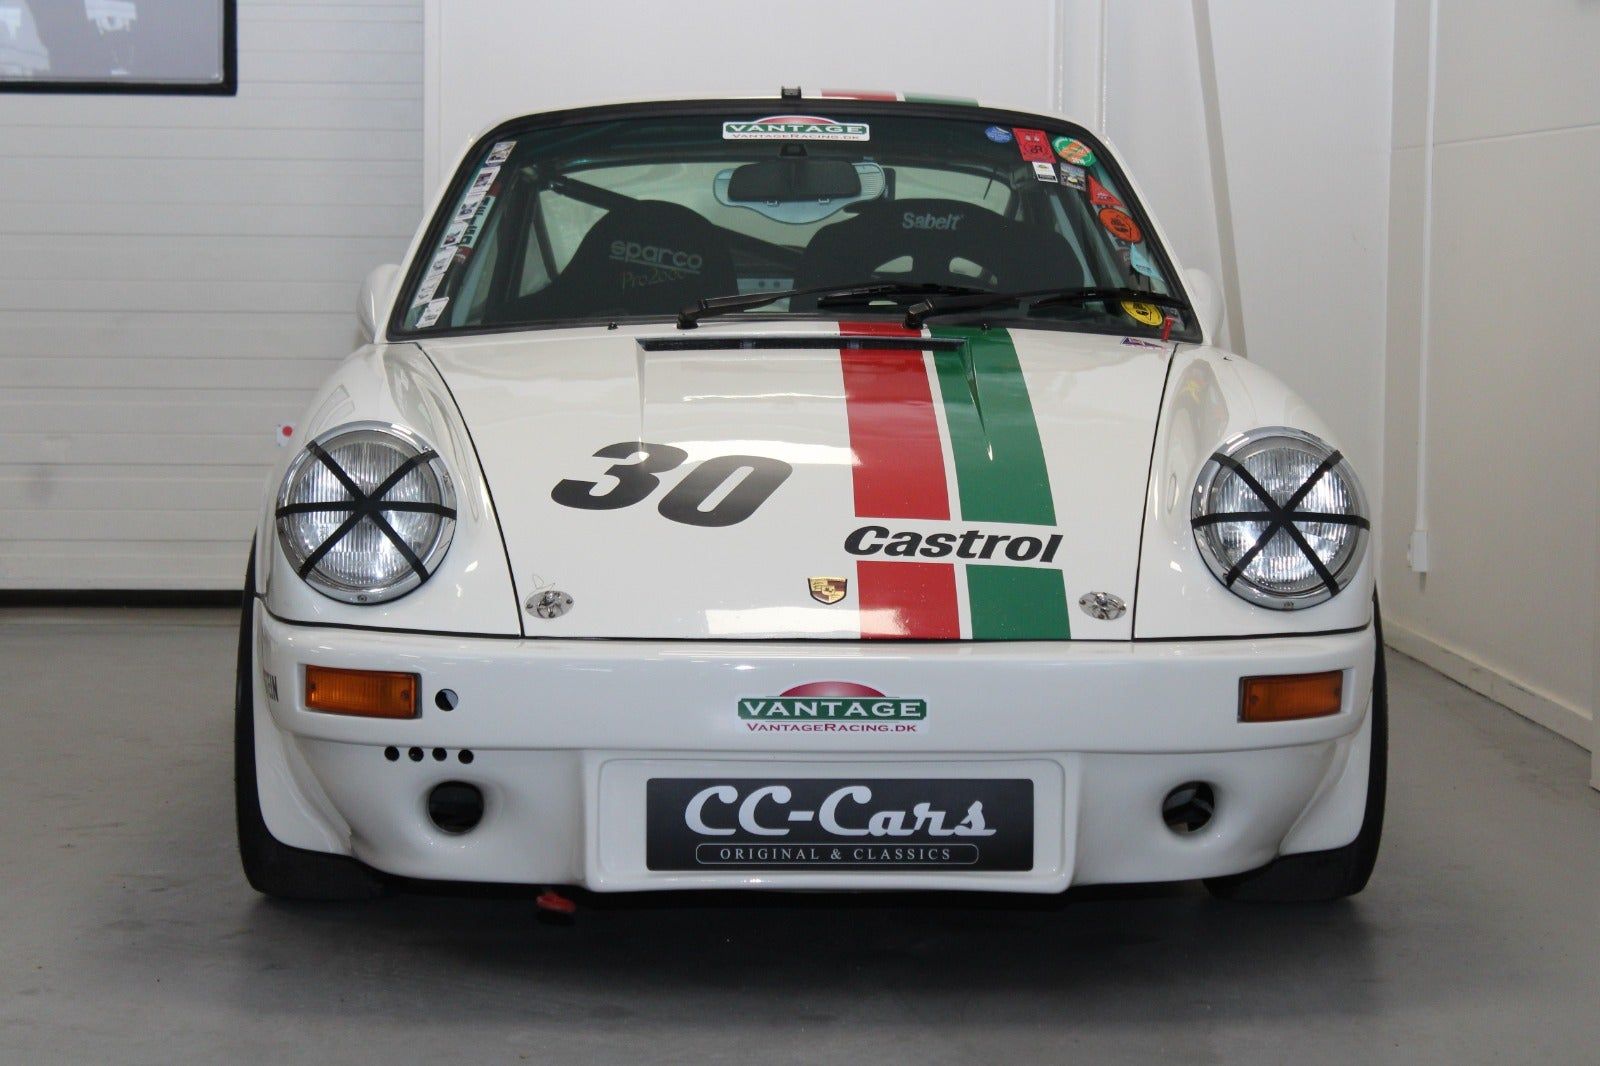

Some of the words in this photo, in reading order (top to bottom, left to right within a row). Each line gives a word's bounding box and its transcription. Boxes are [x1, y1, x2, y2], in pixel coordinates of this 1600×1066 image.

[729, 124, 863, 134] VANTAGE
[610, 240, 702, 270] sparco
[550, 441, 793, 527] 30
[844, 525, 1063, 563] Castrol
[743, 701, 921, 717] VANTAGE
[684, 785, 997, 836] CC-Cars
[720, 848, 820, 860] ORIGINAL
[831, 848, 843, 860] &
[853, 848, 951, 860] CLASSICS
